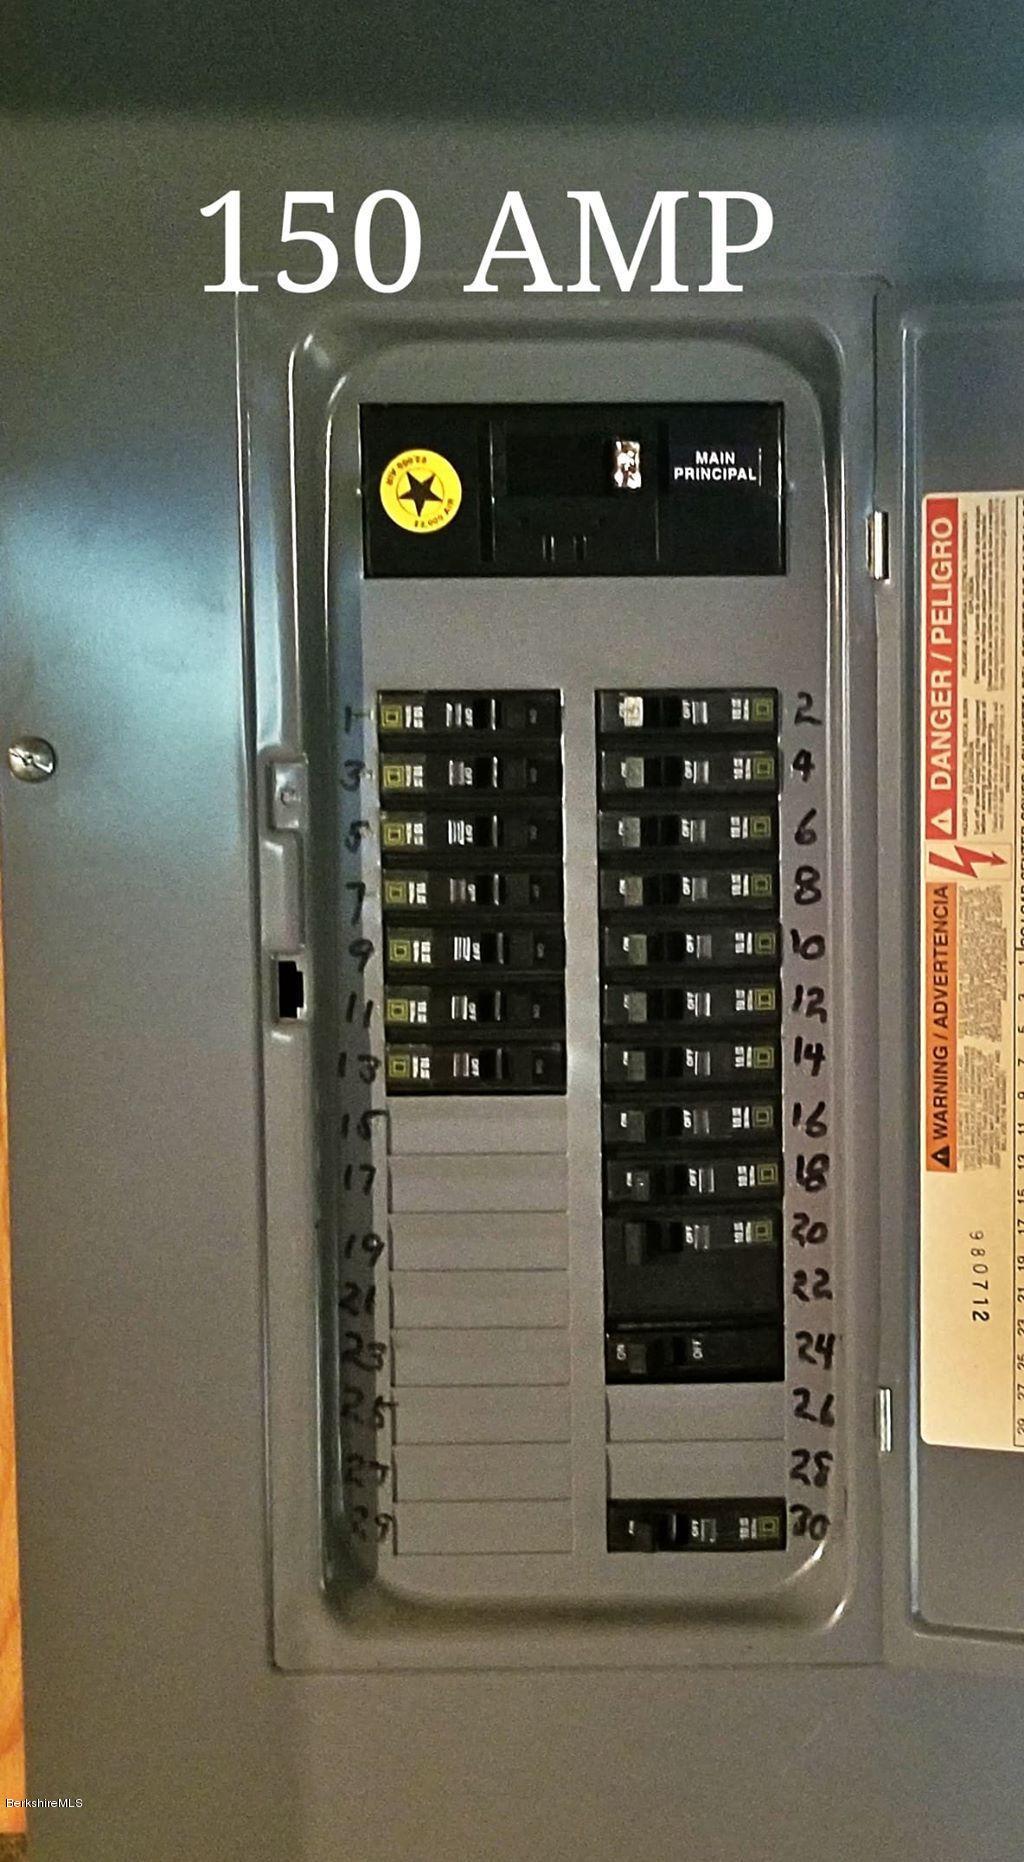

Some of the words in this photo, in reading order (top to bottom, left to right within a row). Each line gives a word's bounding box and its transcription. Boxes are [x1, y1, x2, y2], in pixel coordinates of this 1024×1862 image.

[674, 467, 757, 481] PRINCIPAL
[695, 451, 736, 466] MAIN
[931, 517, 953, 645] PELIGRO
[931, 651, 952, 662] /
[794, 691, 822, 725] 2
[931, 670, 952, 790] DANGER
[793, 748, 815, 782] 4
[794, 808, 817, 845] 6
[347, 881, 365, 924] 7
[794, 865, 822, 905] 8
[349, 938, 374, 972] 9
[790, 928, 826, 961] 10
[933, 886, 948, 1028] ADVERTENCIA
[346, 991, 373, 1028] 11
[792, 984, 828, 1024] 12
[794, 1036, 826, 1077] 14
[933, 1046, 948, 1140] WARNING
[792, 1101, 828, 1138] 16
[344, 1163, 376, 1196] 17
[796, 1153, 830, 1192] 18
[791, 1212, 828, 1248] 20
[344, 1232, 385, 1267] 19
[792, 1267, 833, 1302] 22
[969, 1230, 990, 1322] 980712
[795, 1330, 836, 1370] 24
[793, 1387, 835, 1427] 26
[789, 1448, 833, 1489] 28
